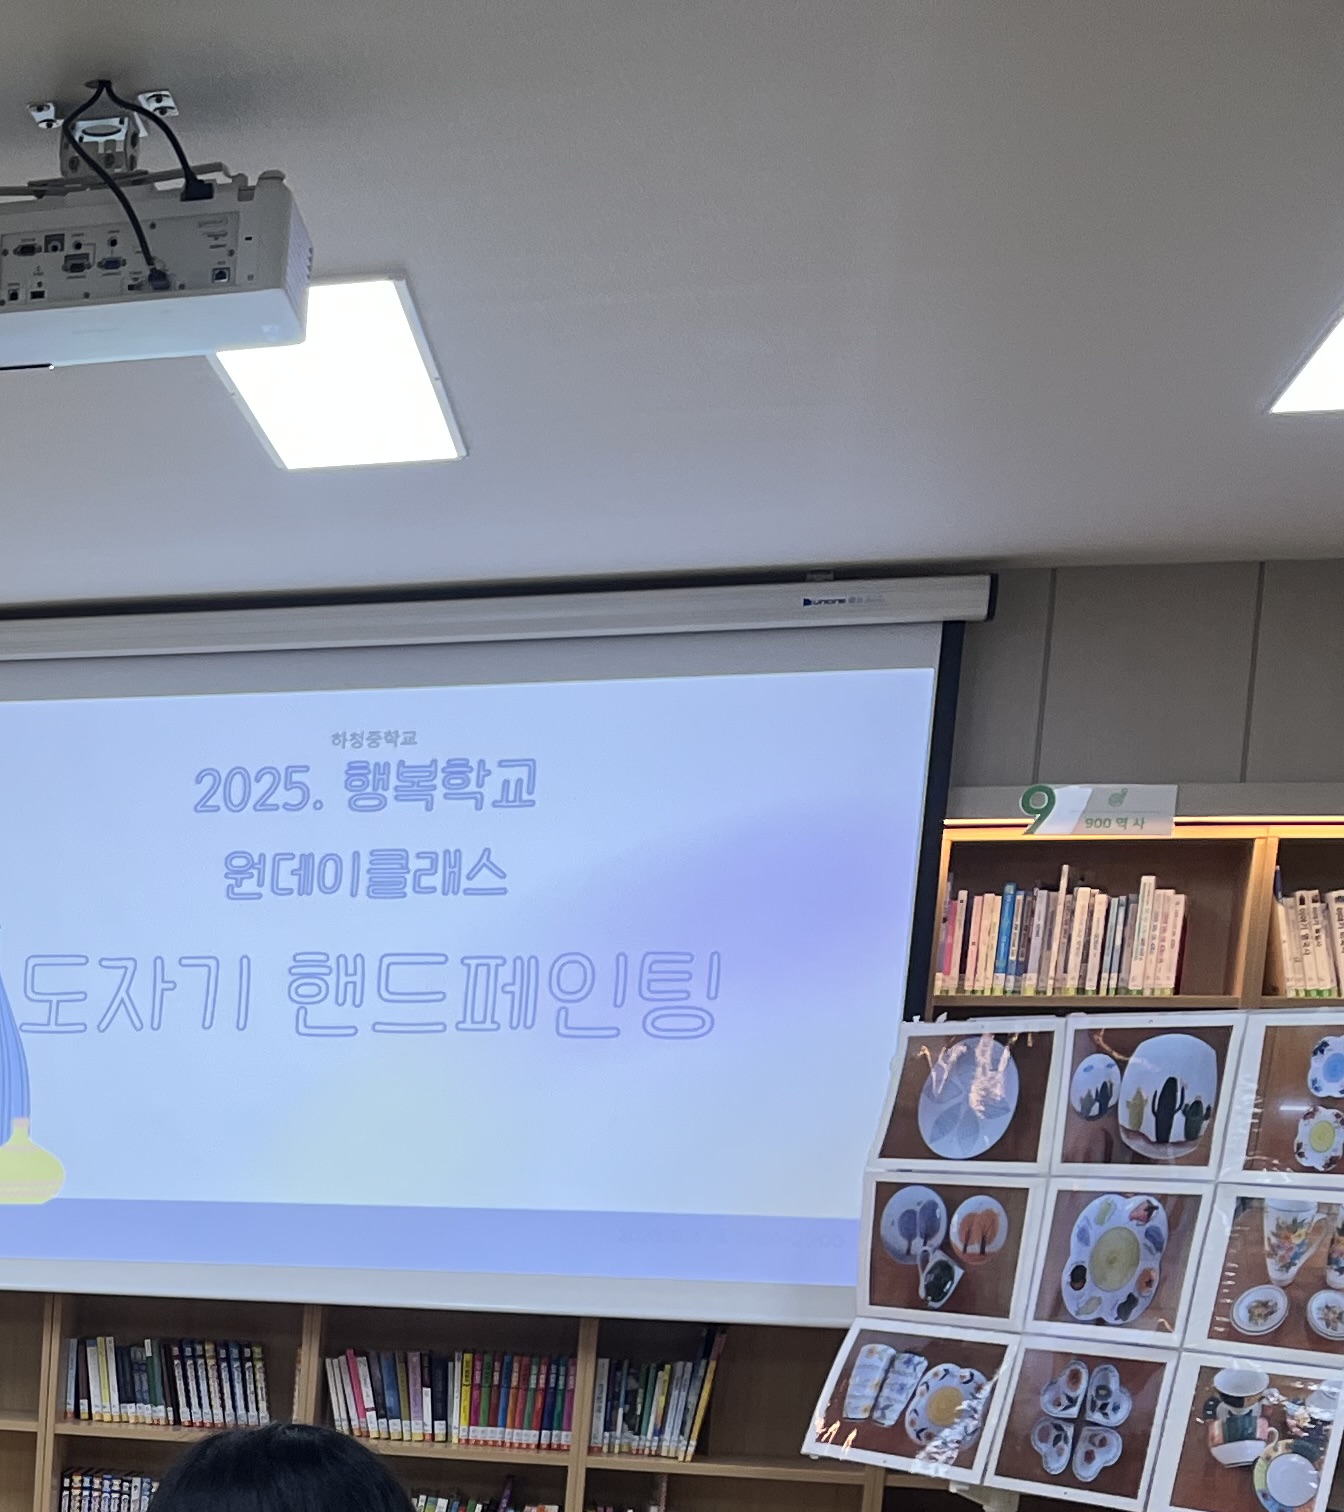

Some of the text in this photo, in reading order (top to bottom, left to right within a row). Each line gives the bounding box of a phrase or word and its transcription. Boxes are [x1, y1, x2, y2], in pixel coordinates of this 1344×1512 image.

[331, 730, 419, 749] 하청중학교
[193, 757, 537, 813] 2025. 행복학교
[1020, 784, 1056, 836] 9
[1084, 818, 1112, 829] 900
[223, 847, 509, 900] 원데이클래스
[18, 951, 722, 1041] 도자기 핸드페인팅
